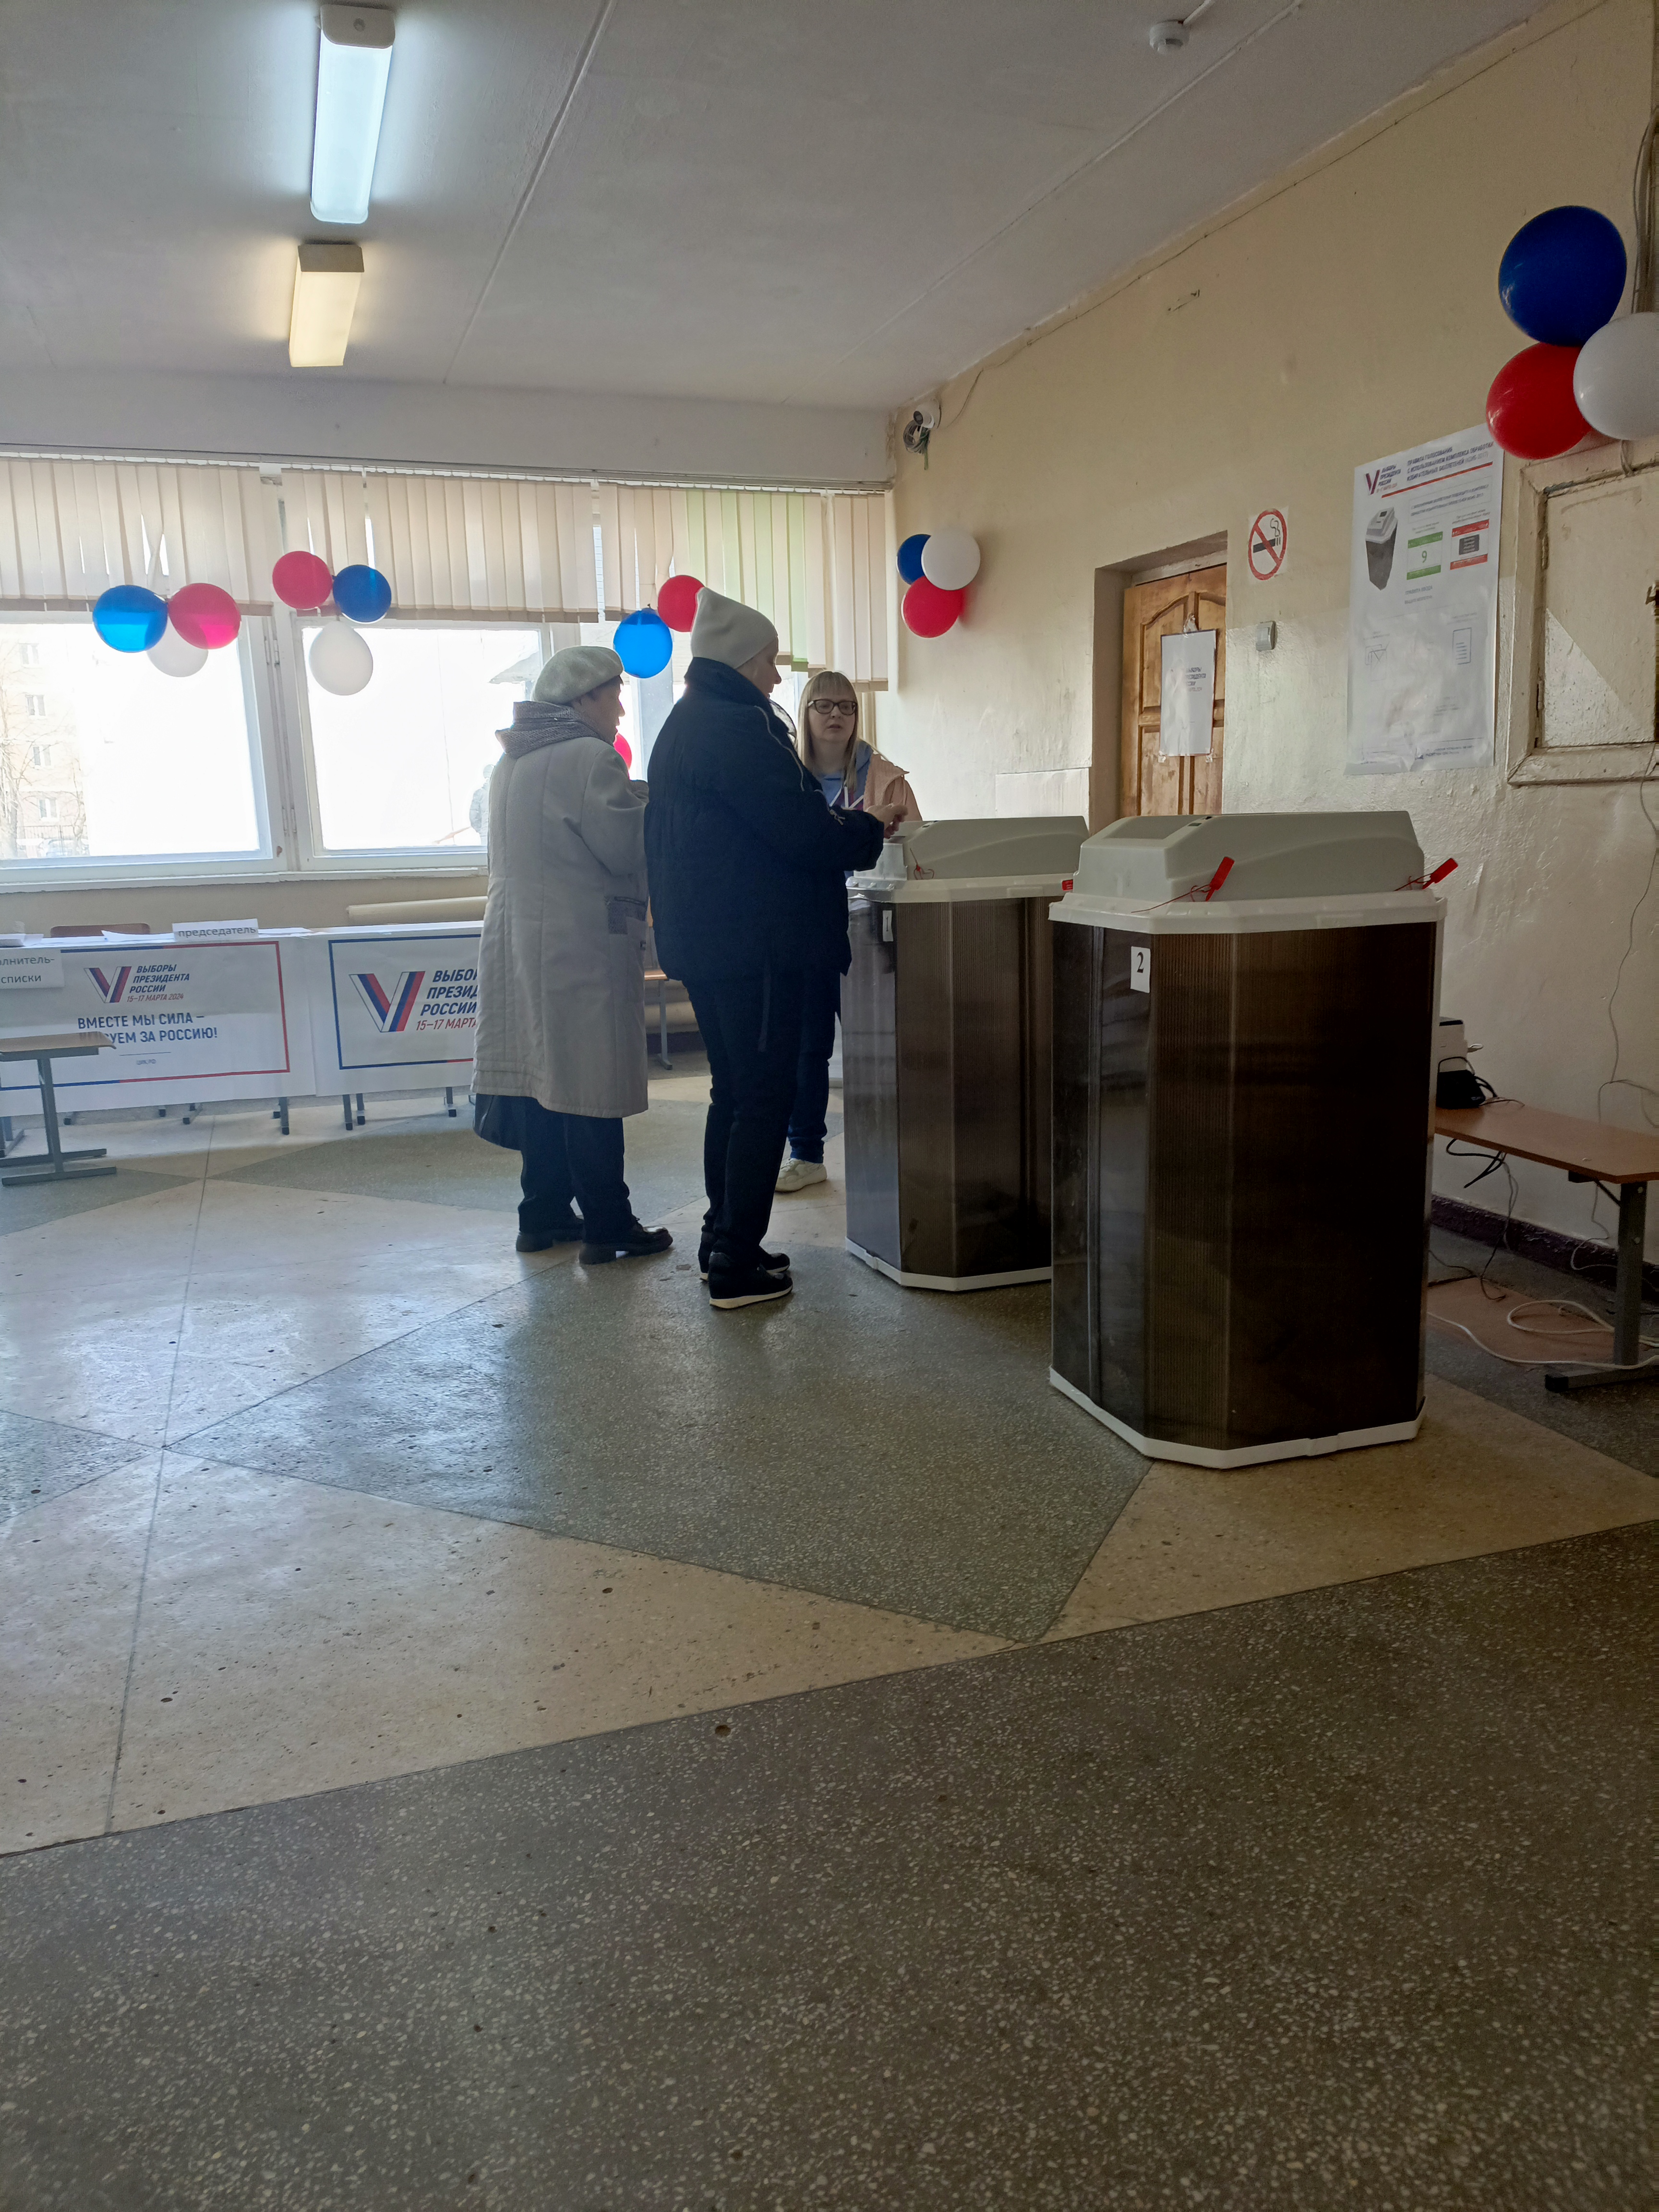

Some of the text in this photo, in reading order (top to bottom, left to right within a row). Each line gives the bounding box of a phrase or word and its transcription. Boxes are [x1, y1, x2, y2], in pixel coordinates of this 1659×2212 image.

[1421, 551, 1428, 563] 9
[886, 916, 889, 932] 1
[179, 927, 256, 938] председатель
[1136, 951, 1144, 974] 2
[136, 964, 177, 974] ВЫБОРЫ
[1, 975, 41, 984] списки
[132, 974, 190, 984] ПРЕЗИДЕНТА
[129, 985, 167, 994] РОССИИ
[426, 985, 478, 999] ПРЕЗИД
[145, 994, 167, 1002] МАРТА
[420, 1001, 477, 1016] РОССИИ
[78, 1015, 129, 1029] ВМЕСТЕ
[132, 1014, 155, 1026] МЫ
[159, 1012, 193, 1025] СИЛА
[140, 1031, 156, 1043] ЗА
[159, 1027, 217, 1041] РОССИЮ!
